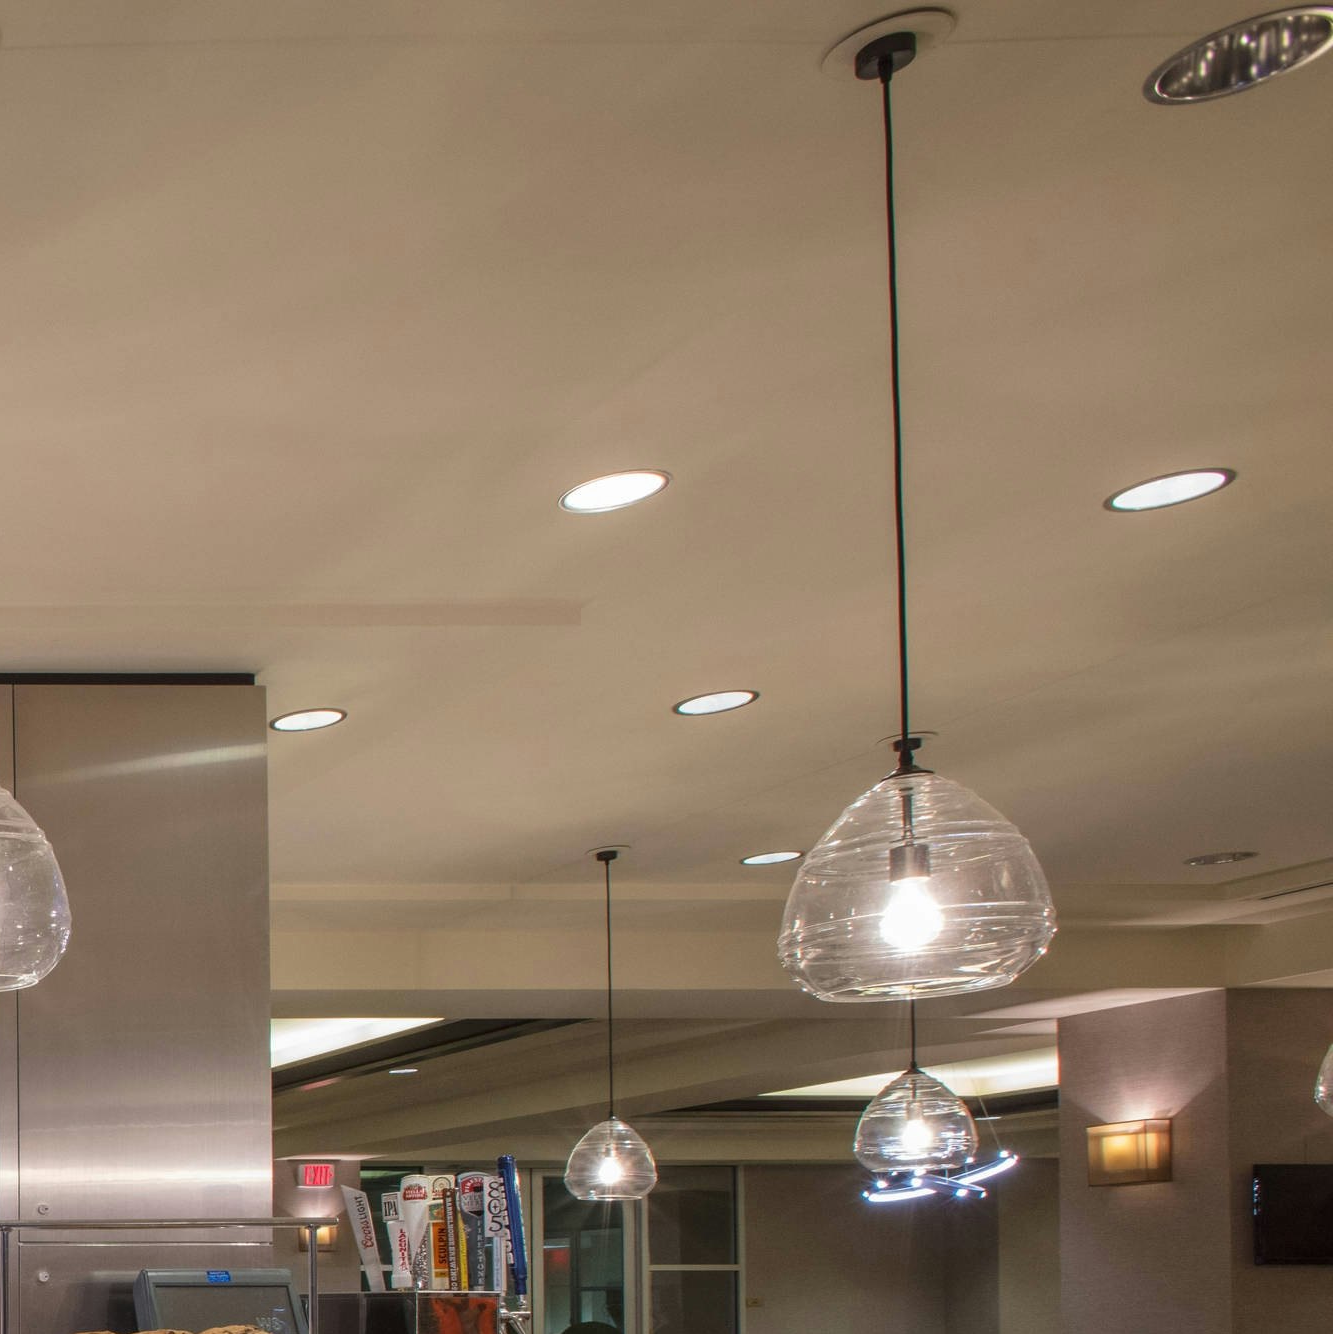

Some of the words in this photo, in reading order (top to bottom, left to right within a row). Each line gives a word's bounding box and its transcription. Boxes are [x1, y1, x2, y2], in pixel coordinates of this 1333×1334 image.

[304, 1165, 330, 1185] EXIT
[383, 1200, 398, 1217] IPA
[438, 1228, 447, 1265] SCULPIN
